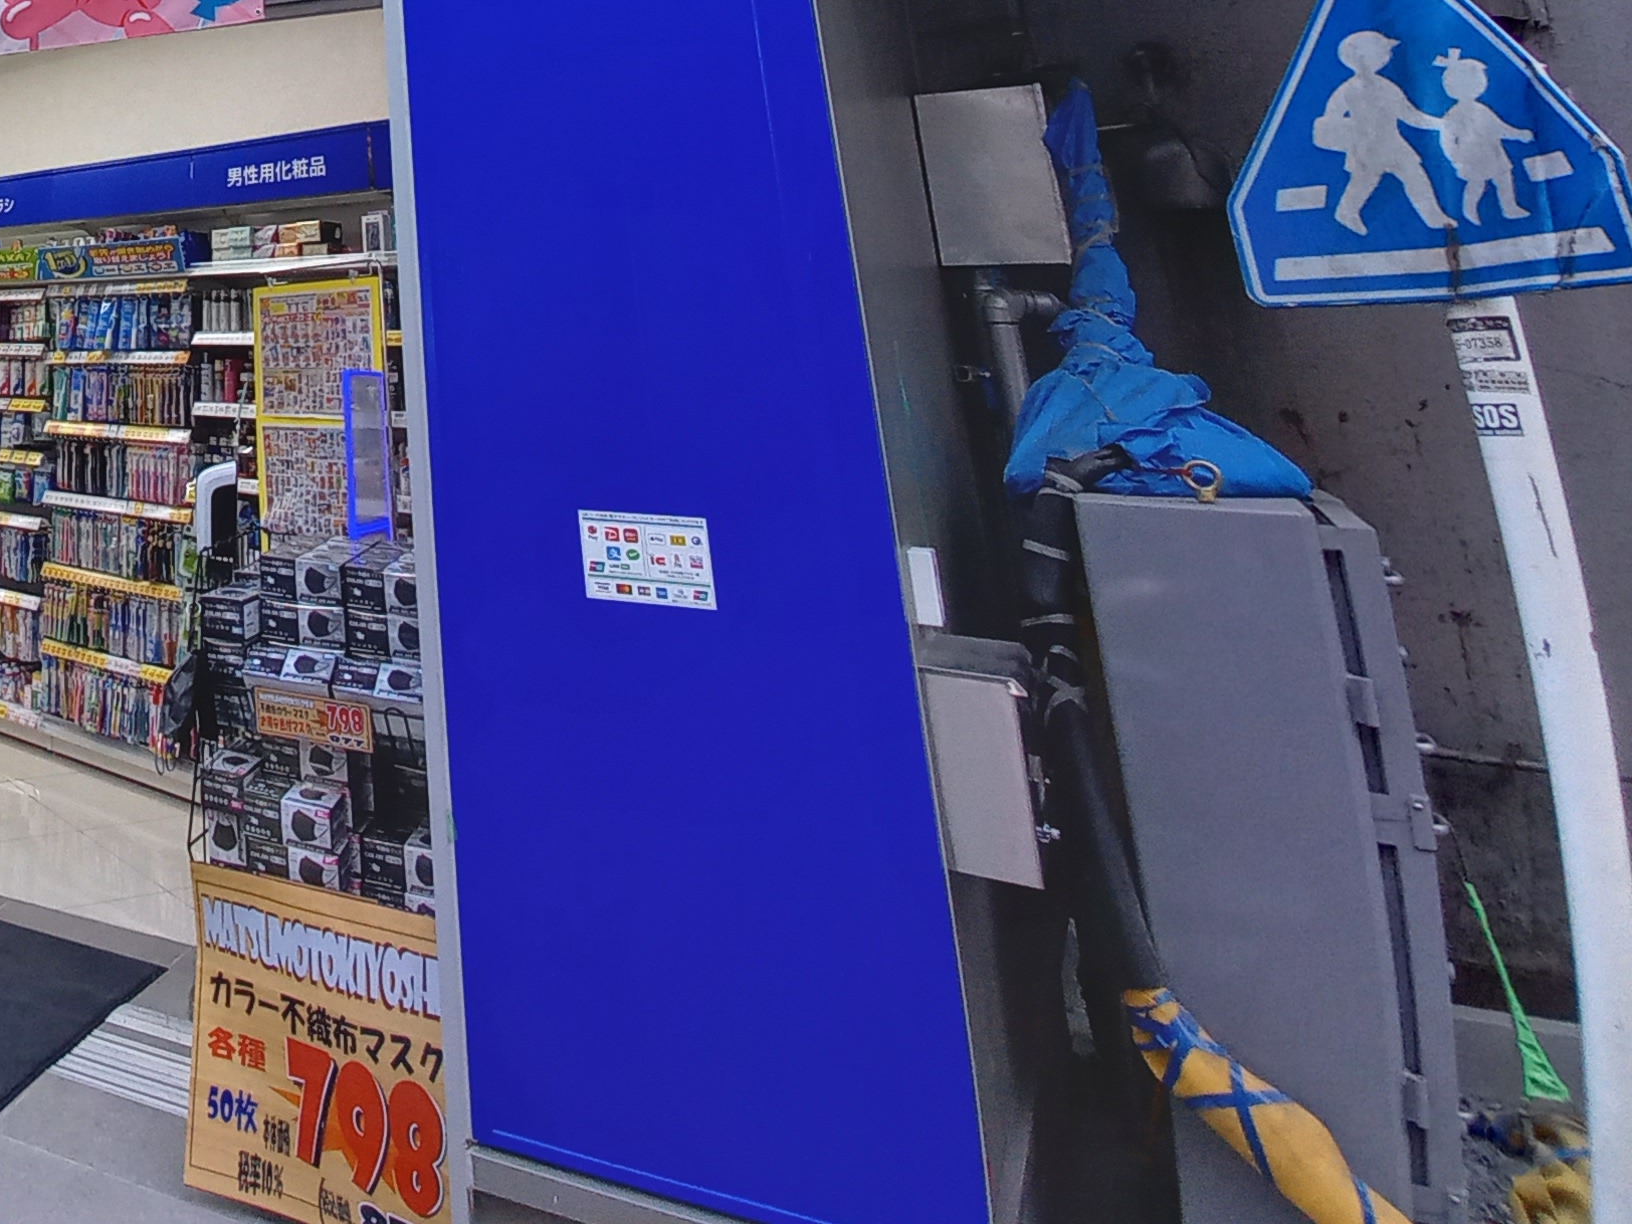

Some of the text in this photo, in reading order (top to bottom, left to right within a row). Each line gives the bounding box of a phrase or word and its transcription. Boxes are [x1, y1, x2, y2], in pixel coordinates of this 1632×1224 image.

[226, 155, 327, 189] 男性用化粧品
[1472, 404, 1519, 428] SOS
[325, 703, 364, 735] 798
[200, 894, 441, 1021] MATSUMOTOKIYOSH
[207, 1026, 267, 1073] 各種
[209, 971, 444, 1082] カラー不織布マスク
[206, 1085, 260, 1134] 50枚
[285, 1036, 447, 1218] 798
